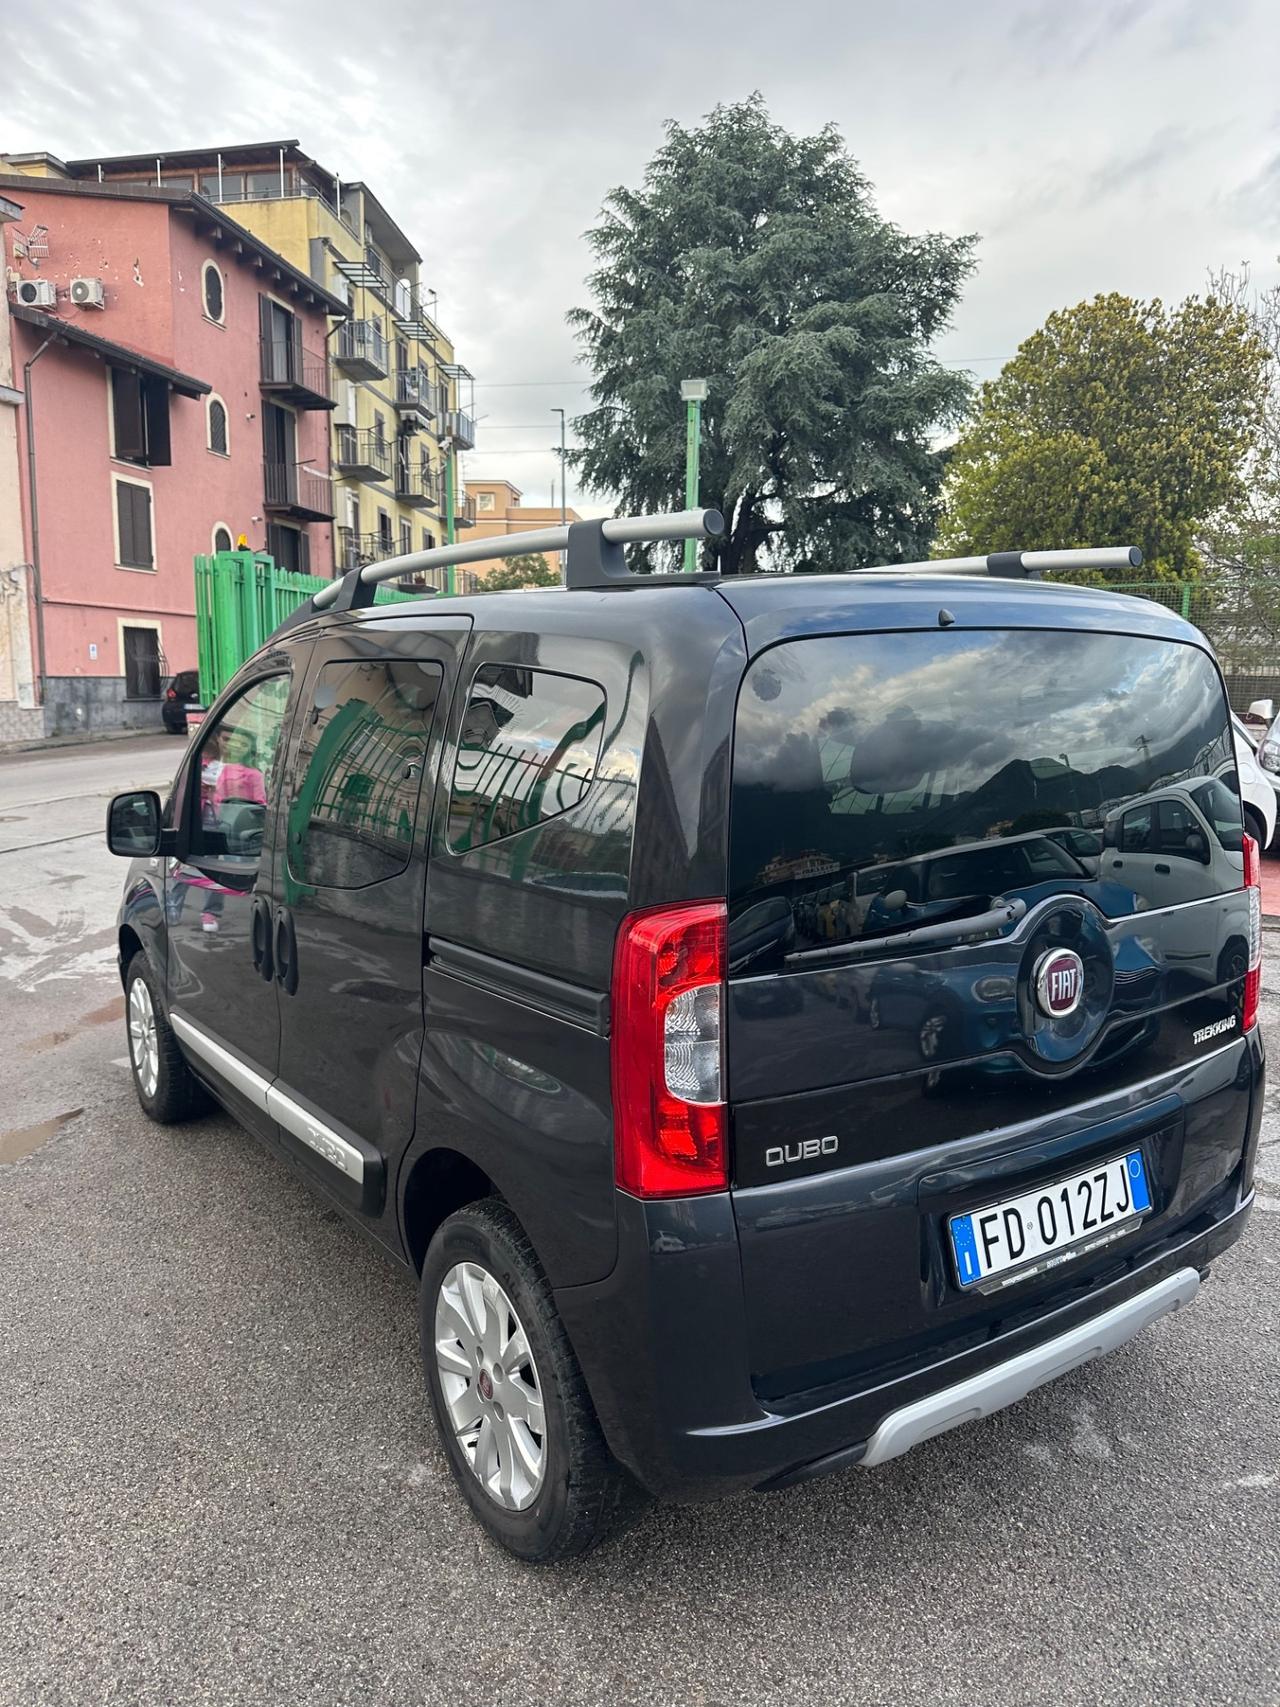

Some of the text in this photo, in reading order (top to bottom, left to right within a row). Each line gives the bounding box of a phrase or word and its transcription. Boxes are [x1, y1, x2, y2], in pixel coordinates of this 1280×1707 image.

[1051, 968, 1077, 1001] FIAT
[1192, 1015, 1236, 1045] TREKKING
[766, 1135, 838, 1167] QUBO
[979, 1207, 1026, 1269] FD
[1037, 1164, 1130, 1246] 012ZJ
